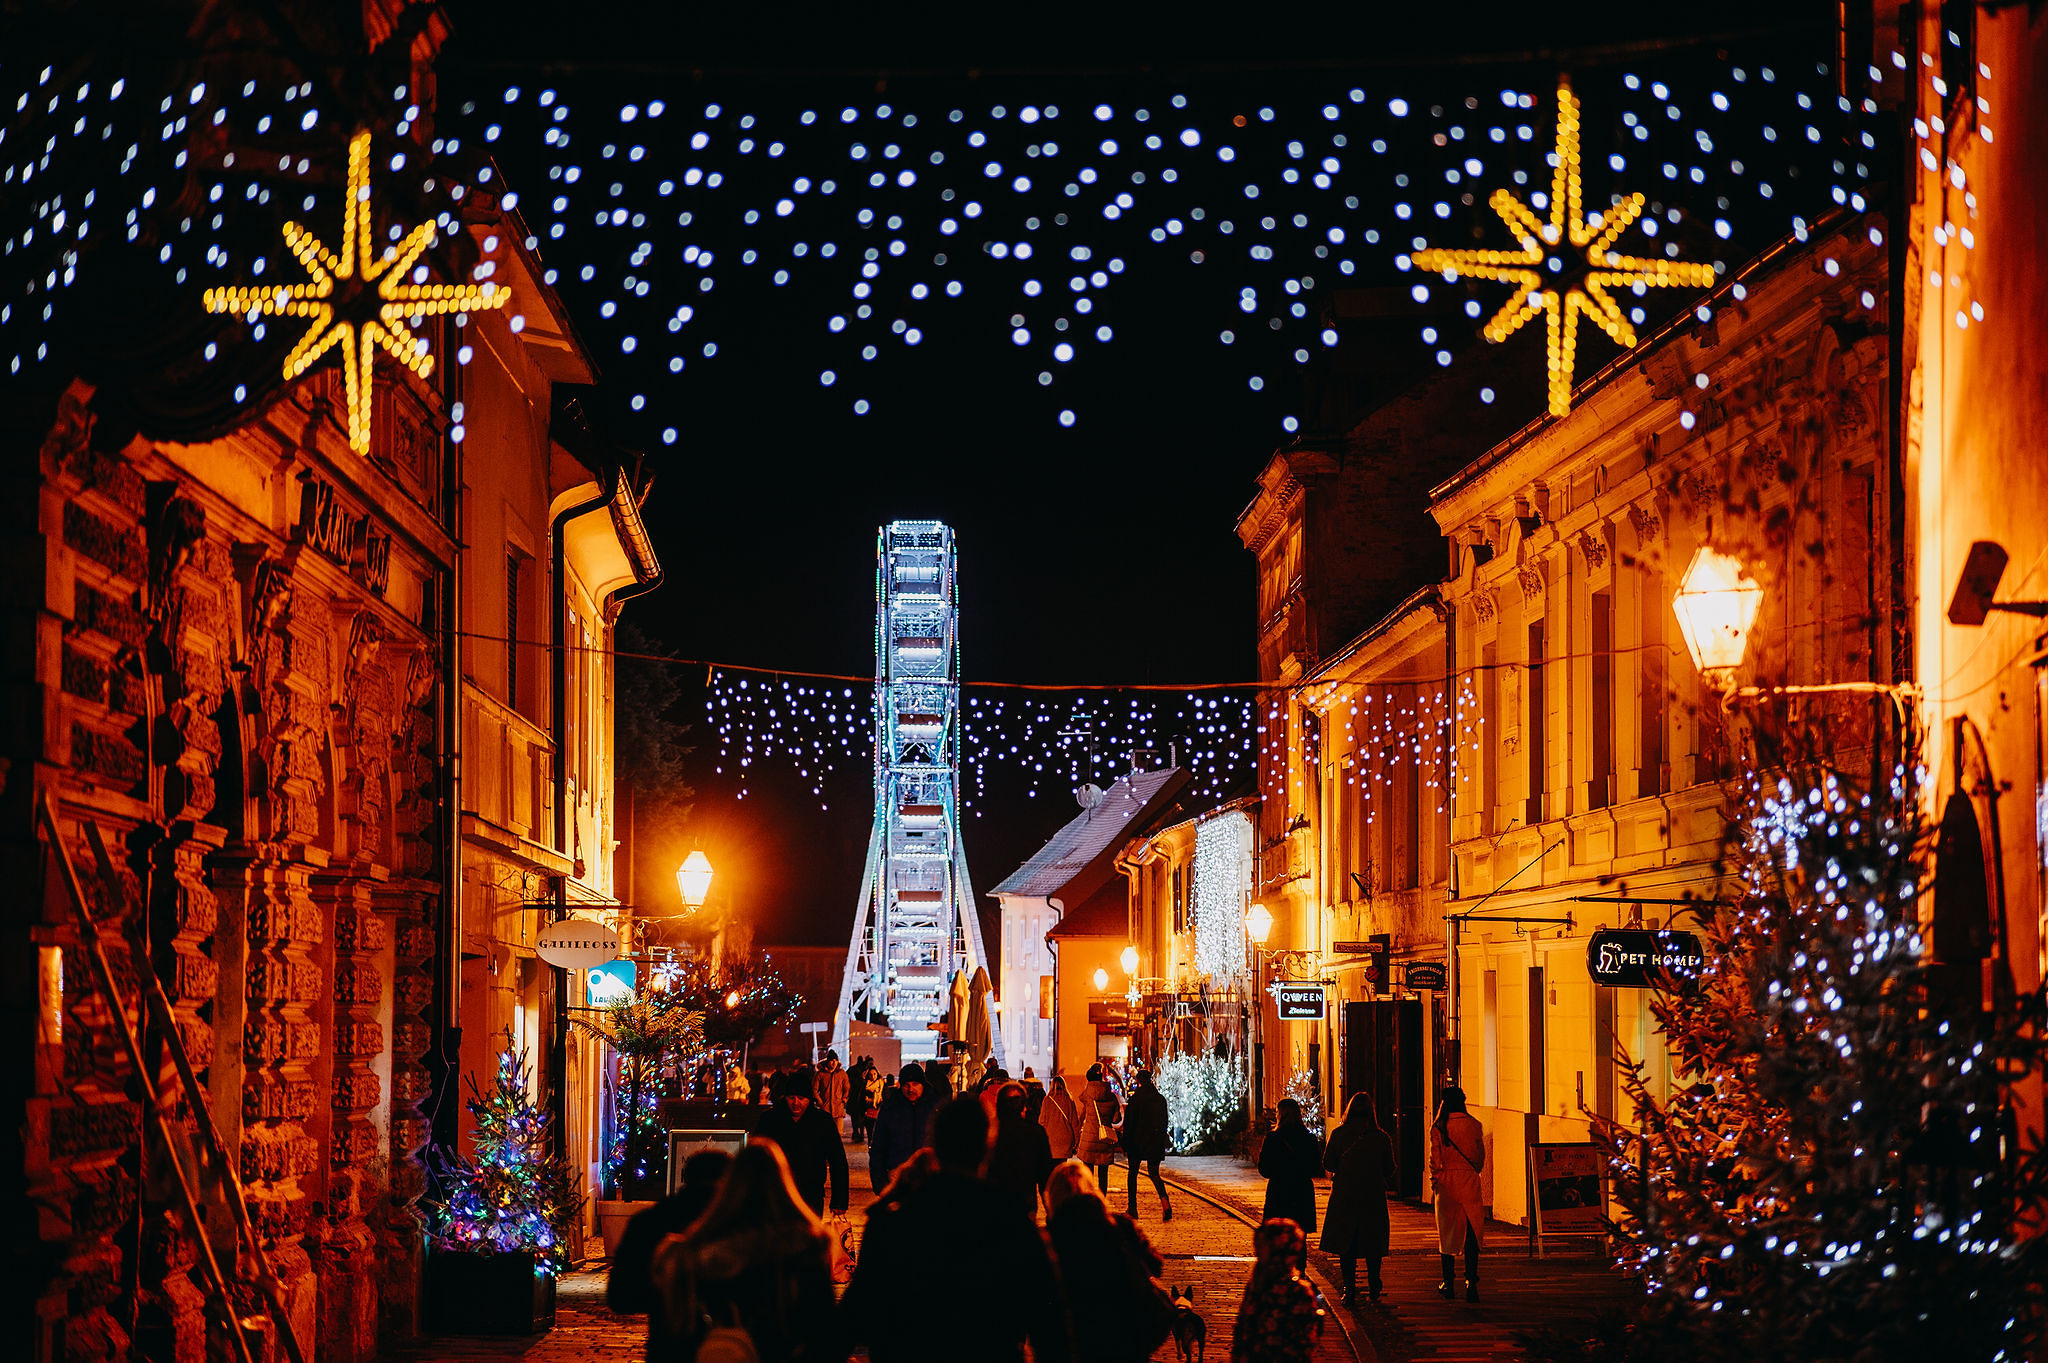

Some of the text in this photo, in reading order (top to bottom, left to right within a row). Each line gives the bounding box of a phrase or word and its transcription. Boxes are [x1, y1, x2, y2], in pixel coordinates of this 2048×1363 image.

[538, 939, 617, 949] GALILEOSS
[1620, 953, 1696, 966] PET HOME
